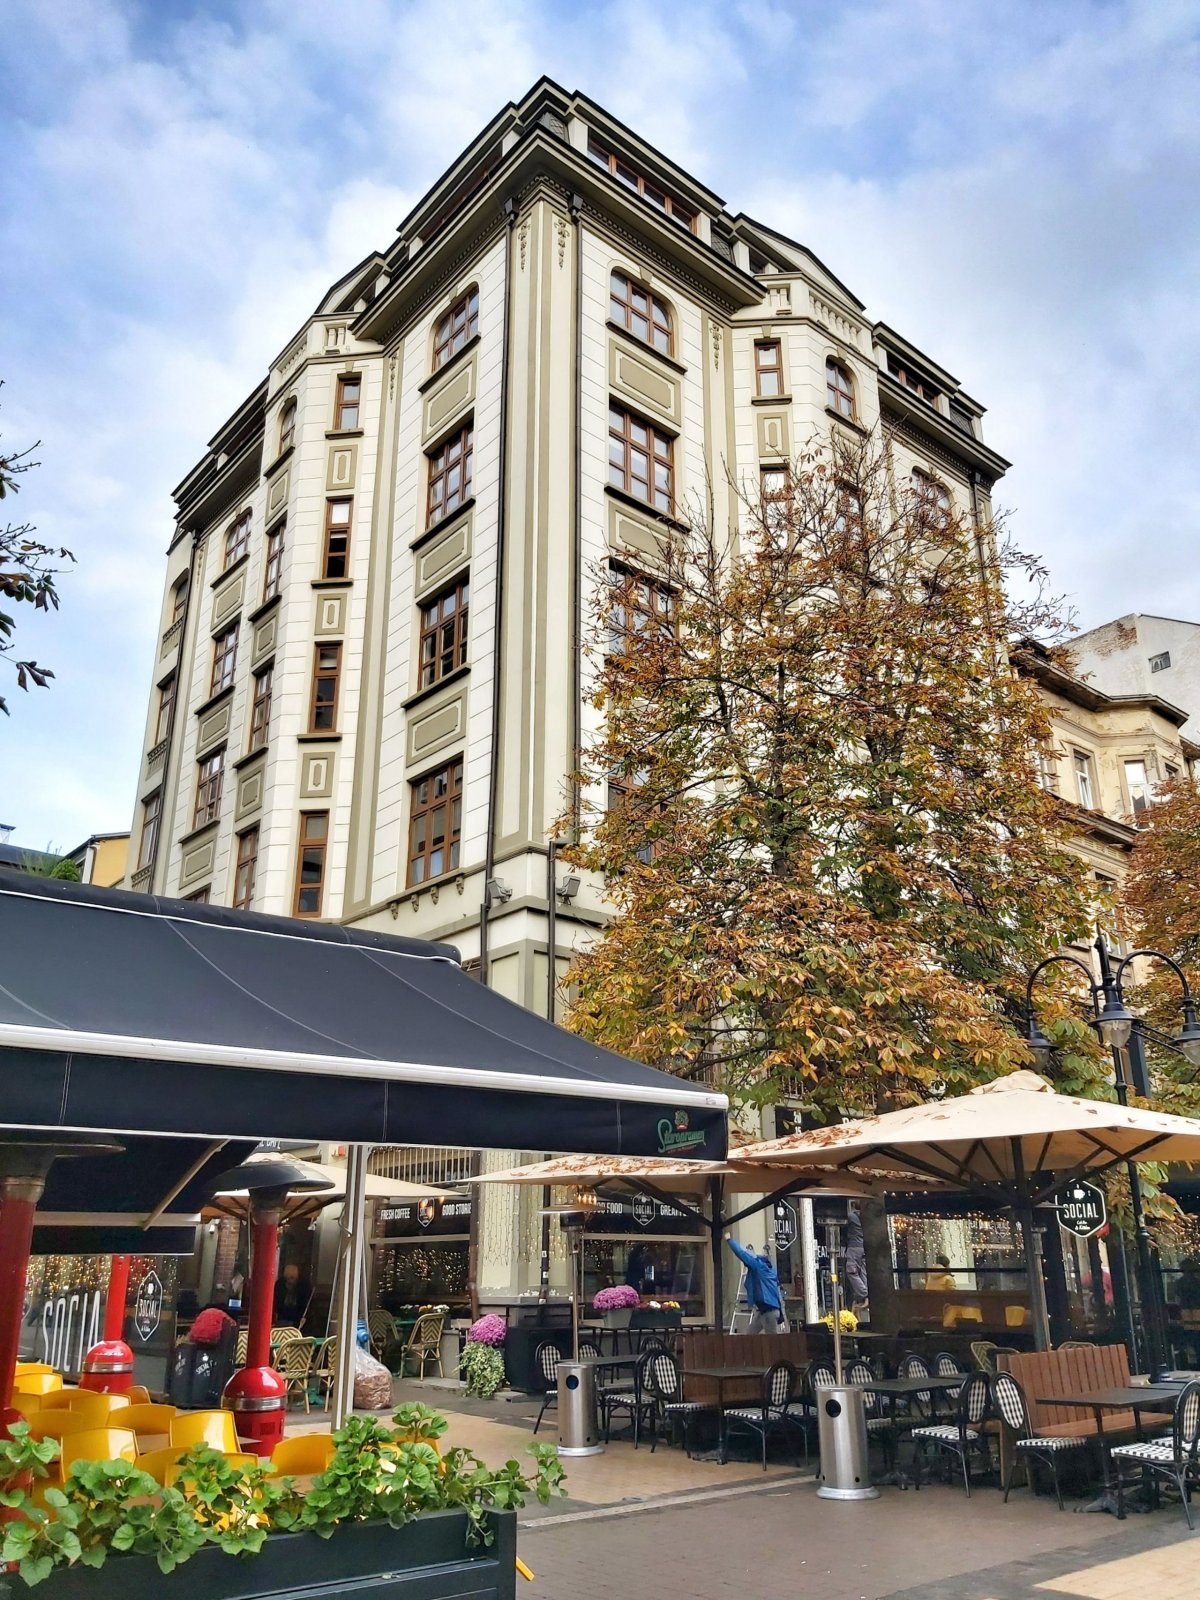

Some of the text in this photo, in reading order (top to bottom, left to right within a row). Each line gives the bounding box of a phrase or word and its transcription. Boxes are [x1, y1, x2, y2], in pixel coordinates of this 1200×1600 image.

[381, 1208, 410, 1220] FRESH COFFEE
[442, 1203, 472, 1216] GOOD STORIE
[606, 1202, 623, 1214] FOOD
[635, 1204, 652, 1215] SOCIAL
[1062, 1203, 1099, 1218] SOCIAL
[774, 1220, 793, 1234] OCIAL
[43, 1290, 101, 1372] SOCIA
